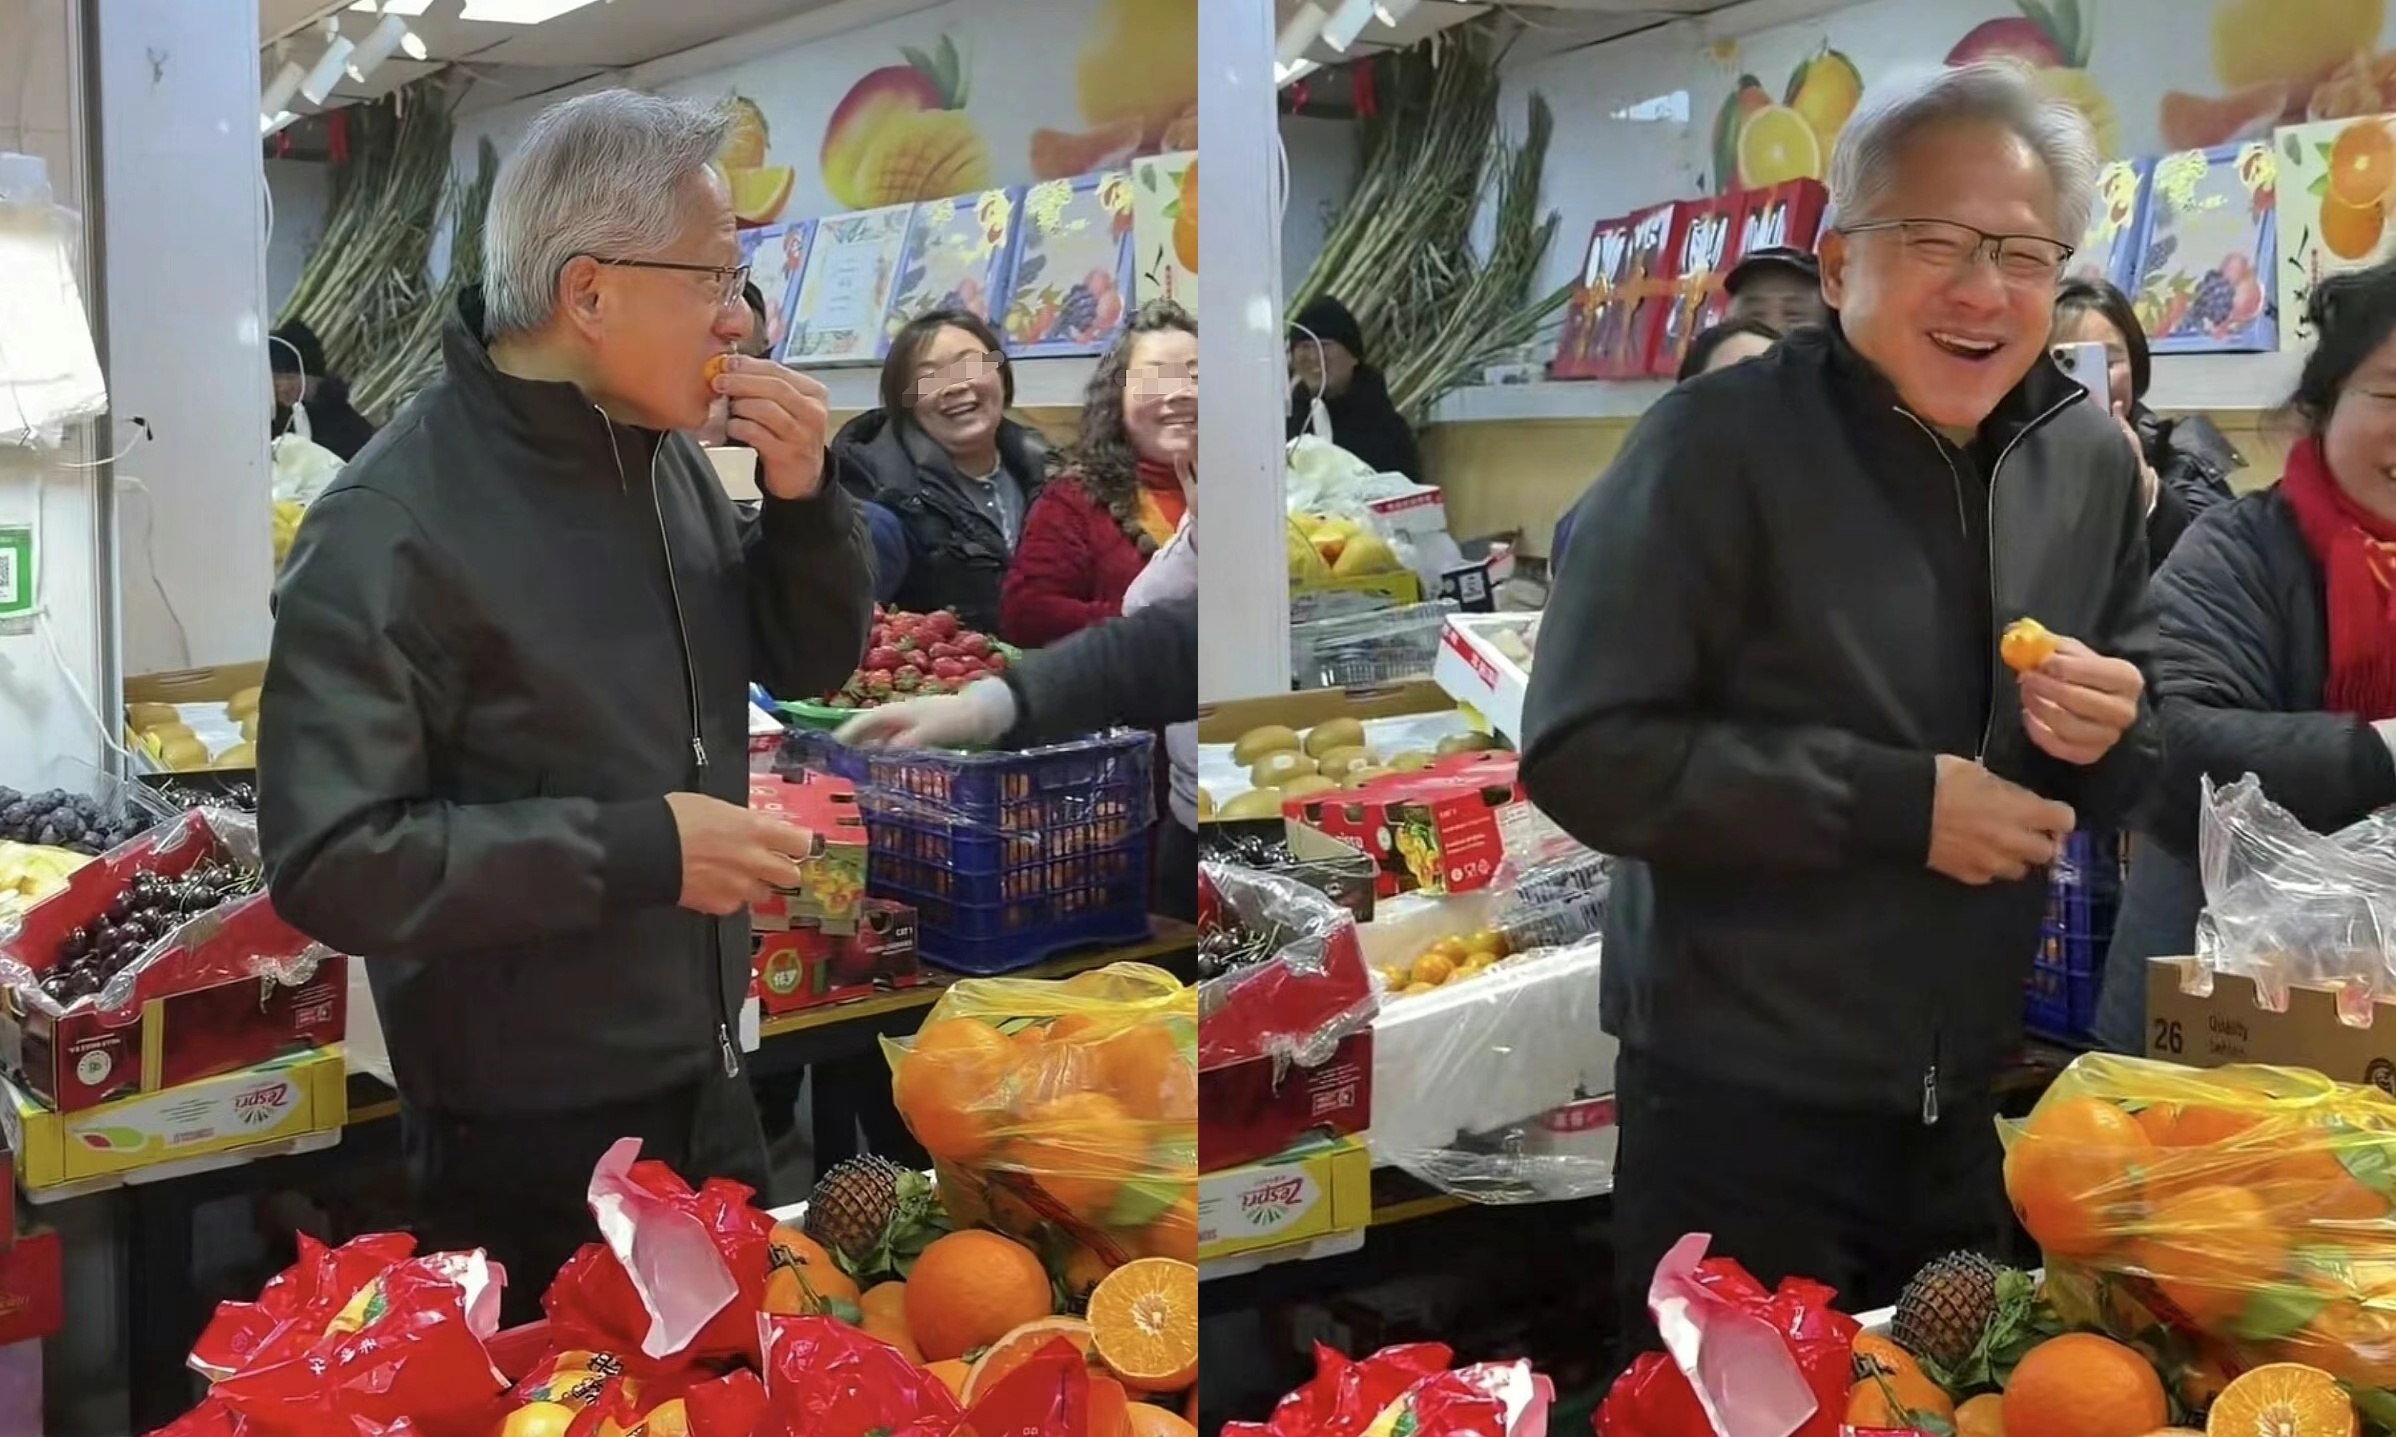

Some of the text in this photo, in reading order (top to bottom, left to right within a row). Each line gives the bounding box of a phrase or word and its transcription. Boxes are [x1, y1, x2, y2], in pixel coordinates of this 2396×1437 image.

[2153, 1017, 2183, 1054] 26
[234, 1083, 289, 1112] Zespri
[1242, 1177, 1304, 1212] Zespri
